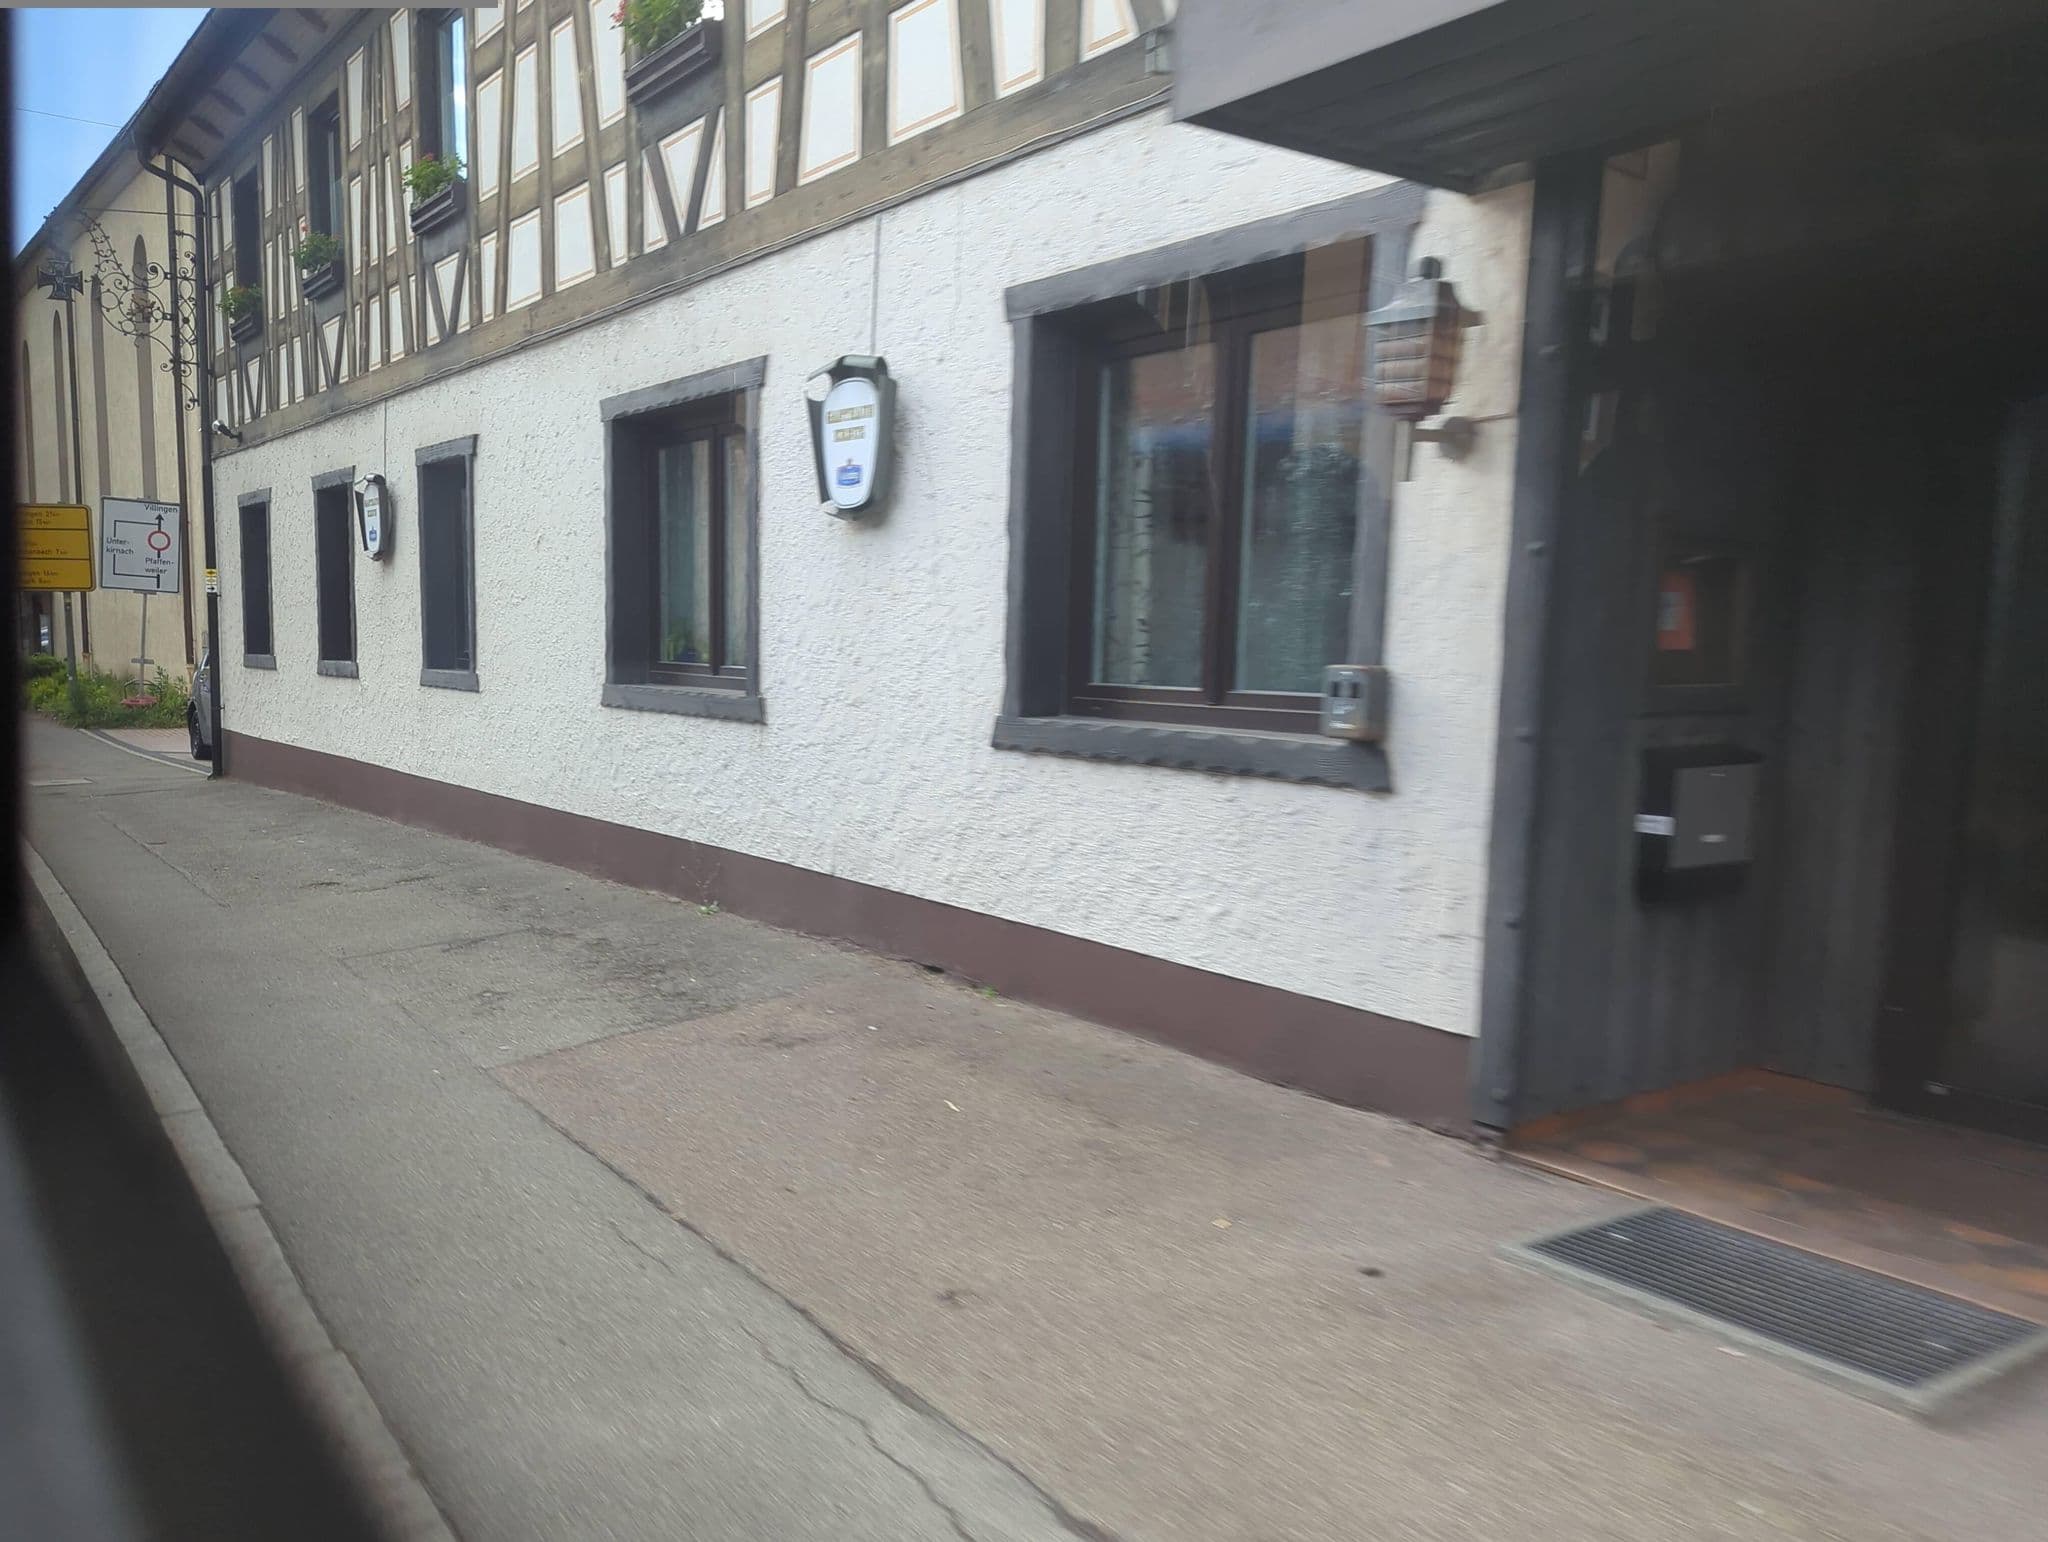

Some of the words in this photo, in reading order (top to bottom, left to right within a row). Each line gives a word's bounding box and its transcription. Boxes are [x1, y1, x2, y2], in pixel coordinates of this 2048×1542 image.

[144, 503, 178, 513] Villingen
[106, 537, 129, 545] Unter-
[106, 546, 134, 554] kirnach
[145, 557, 174, 565] Pfaffen-
